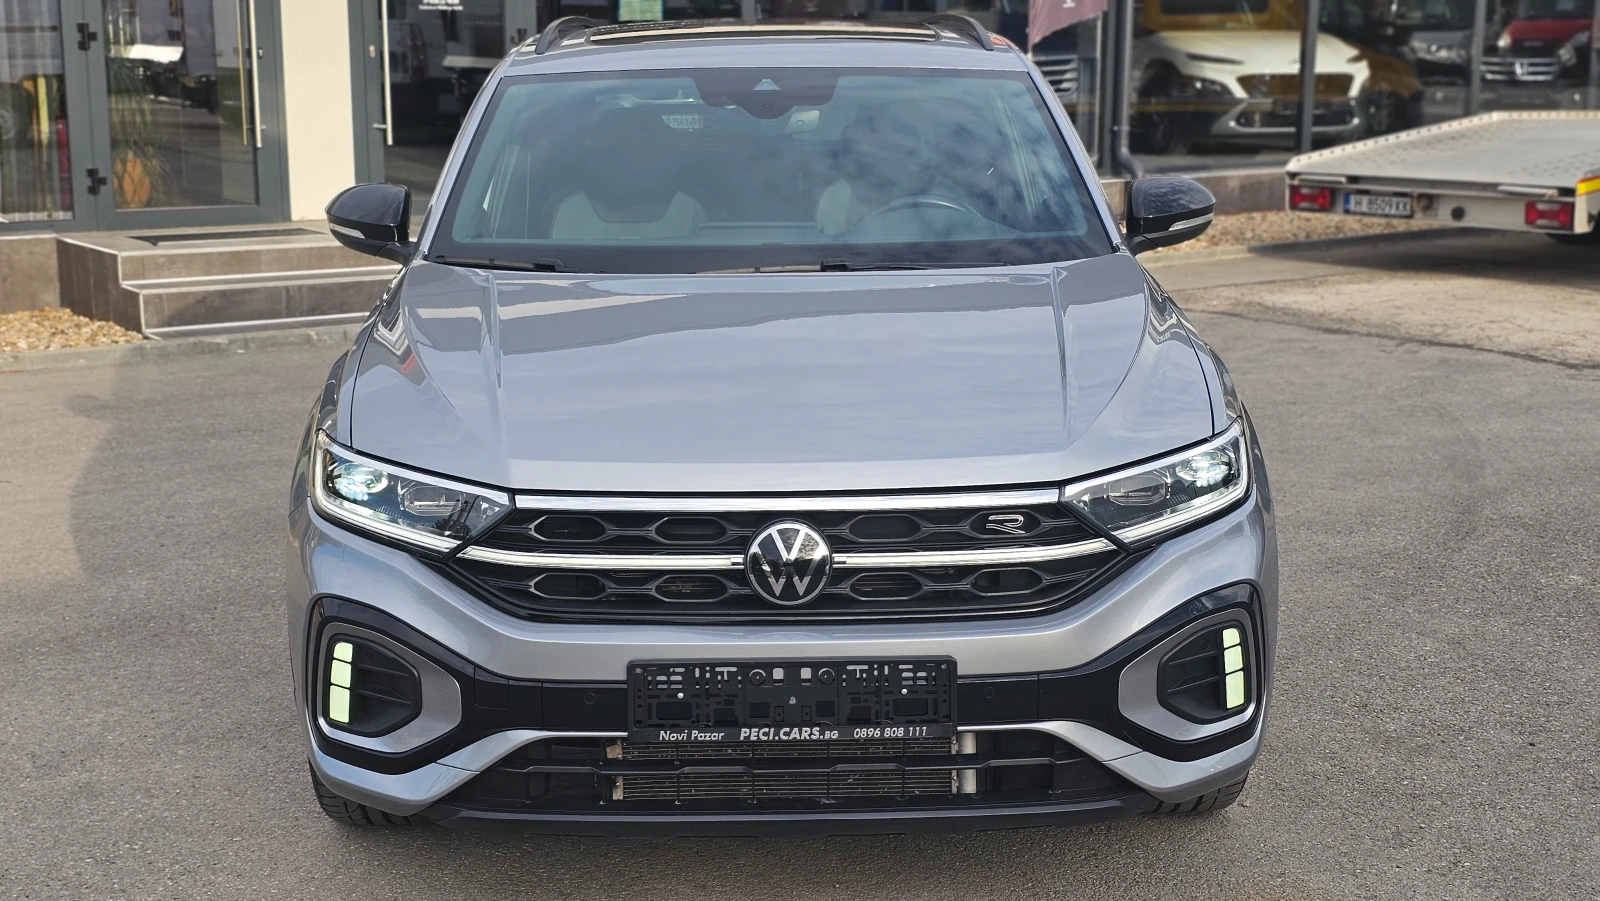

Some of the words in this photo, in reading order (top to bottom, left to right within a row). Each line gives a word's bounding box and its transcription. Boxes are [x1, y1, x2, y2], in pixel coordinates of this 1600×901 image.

[659, 730, 688, 740] Novi
[691, 730, 725, 740] Pazar
[853, 728, 881, 738] 0896
[884, 727, 904, 737] 808
[908, 726, 927, 737] 111
